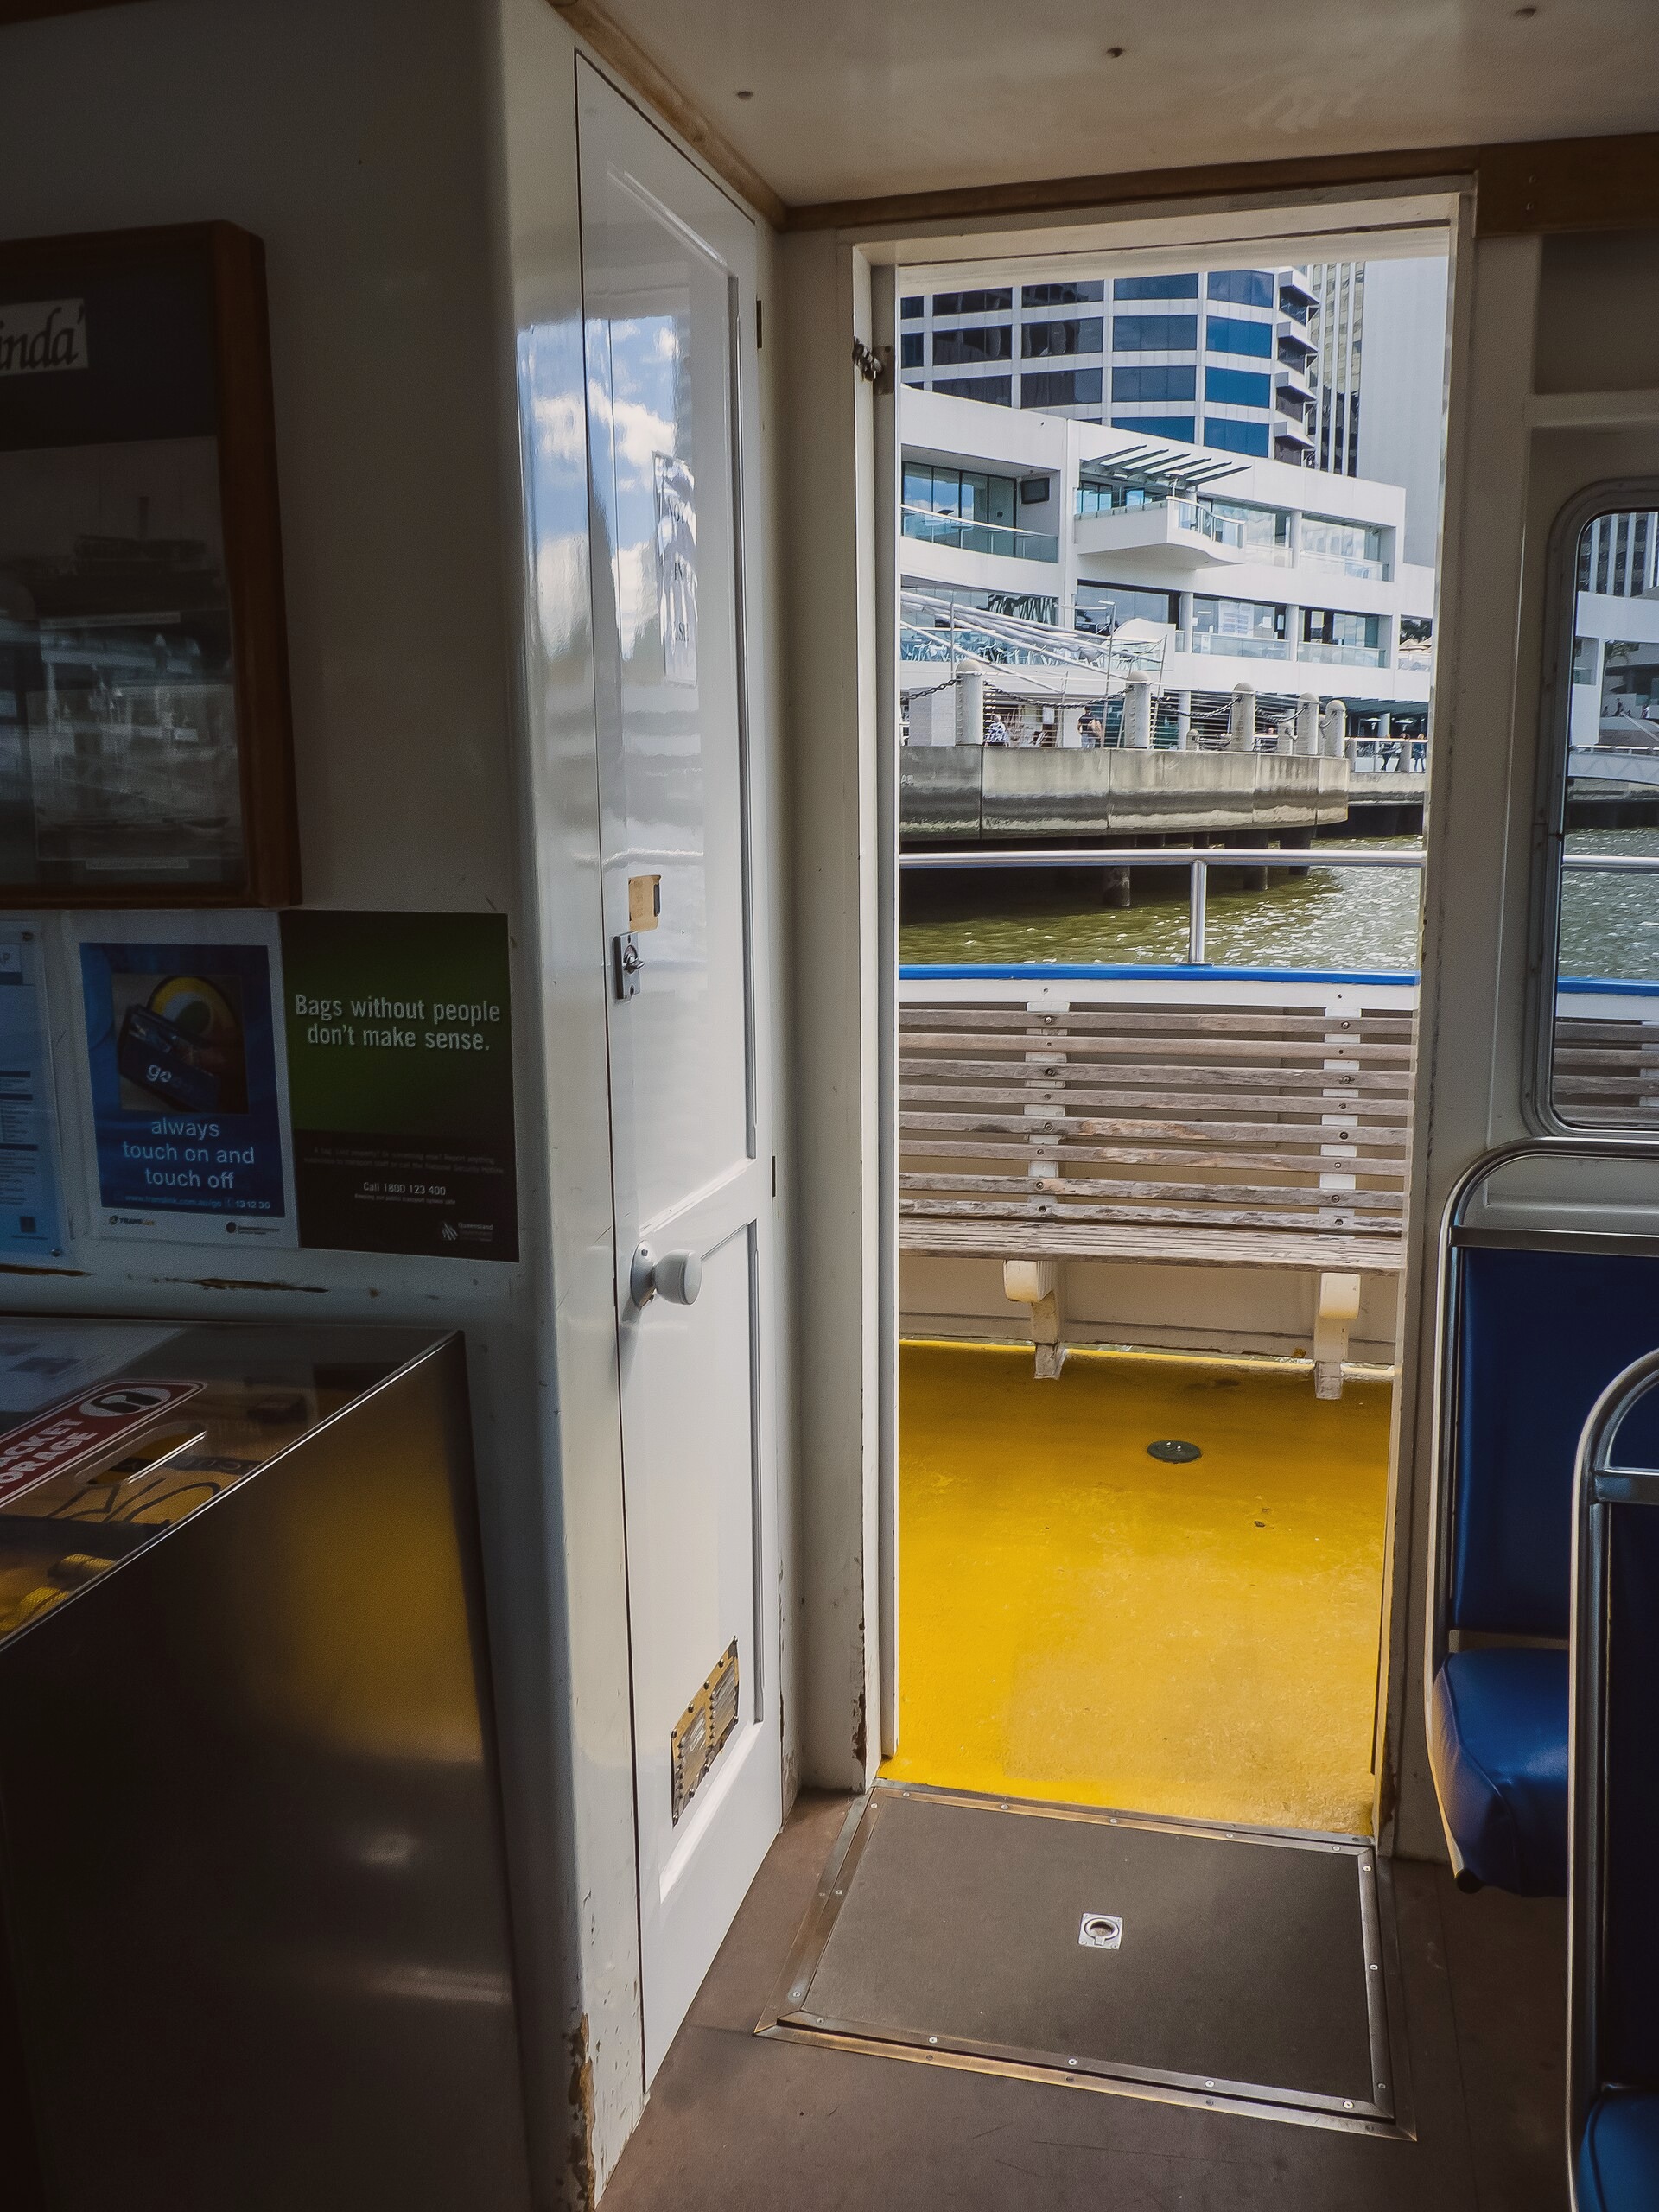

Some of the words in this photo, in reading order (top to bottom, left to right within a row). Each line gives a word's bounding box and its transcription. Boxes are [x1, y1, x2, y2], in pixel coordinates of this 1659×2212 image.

[295, 994, 343, 1021] Bags
[350, 995, 425, 1020] without
[433, 1001, 500, 1027] people
[308, 1022, 355, 1046] don't
[362, 1026, 416, 1047] make
[424, 1032, 490, 1050] sense.
[146, 1064, 172, 1082] go
[151, 1117, 220, 1140] always
[122, 1141, 178, 1160] touch
[184, 1148, 209, 1162] on
[216, 1146, 255, 1164] and
[144, 1168, 200, 1187] touch
[207, 1172, 235, 1189] off
[363, 1182, 380, 1192] Call
[384, 1183, 405, 1193] 1800
[410, 1185, 425, 1195] 123
[427, 1186, 446, 1196] 400
[235, 1200, 245, 1209] 13
[258, 1201, 270, 1210] 30
[0, 1432, 99, 1488] ORAGE
